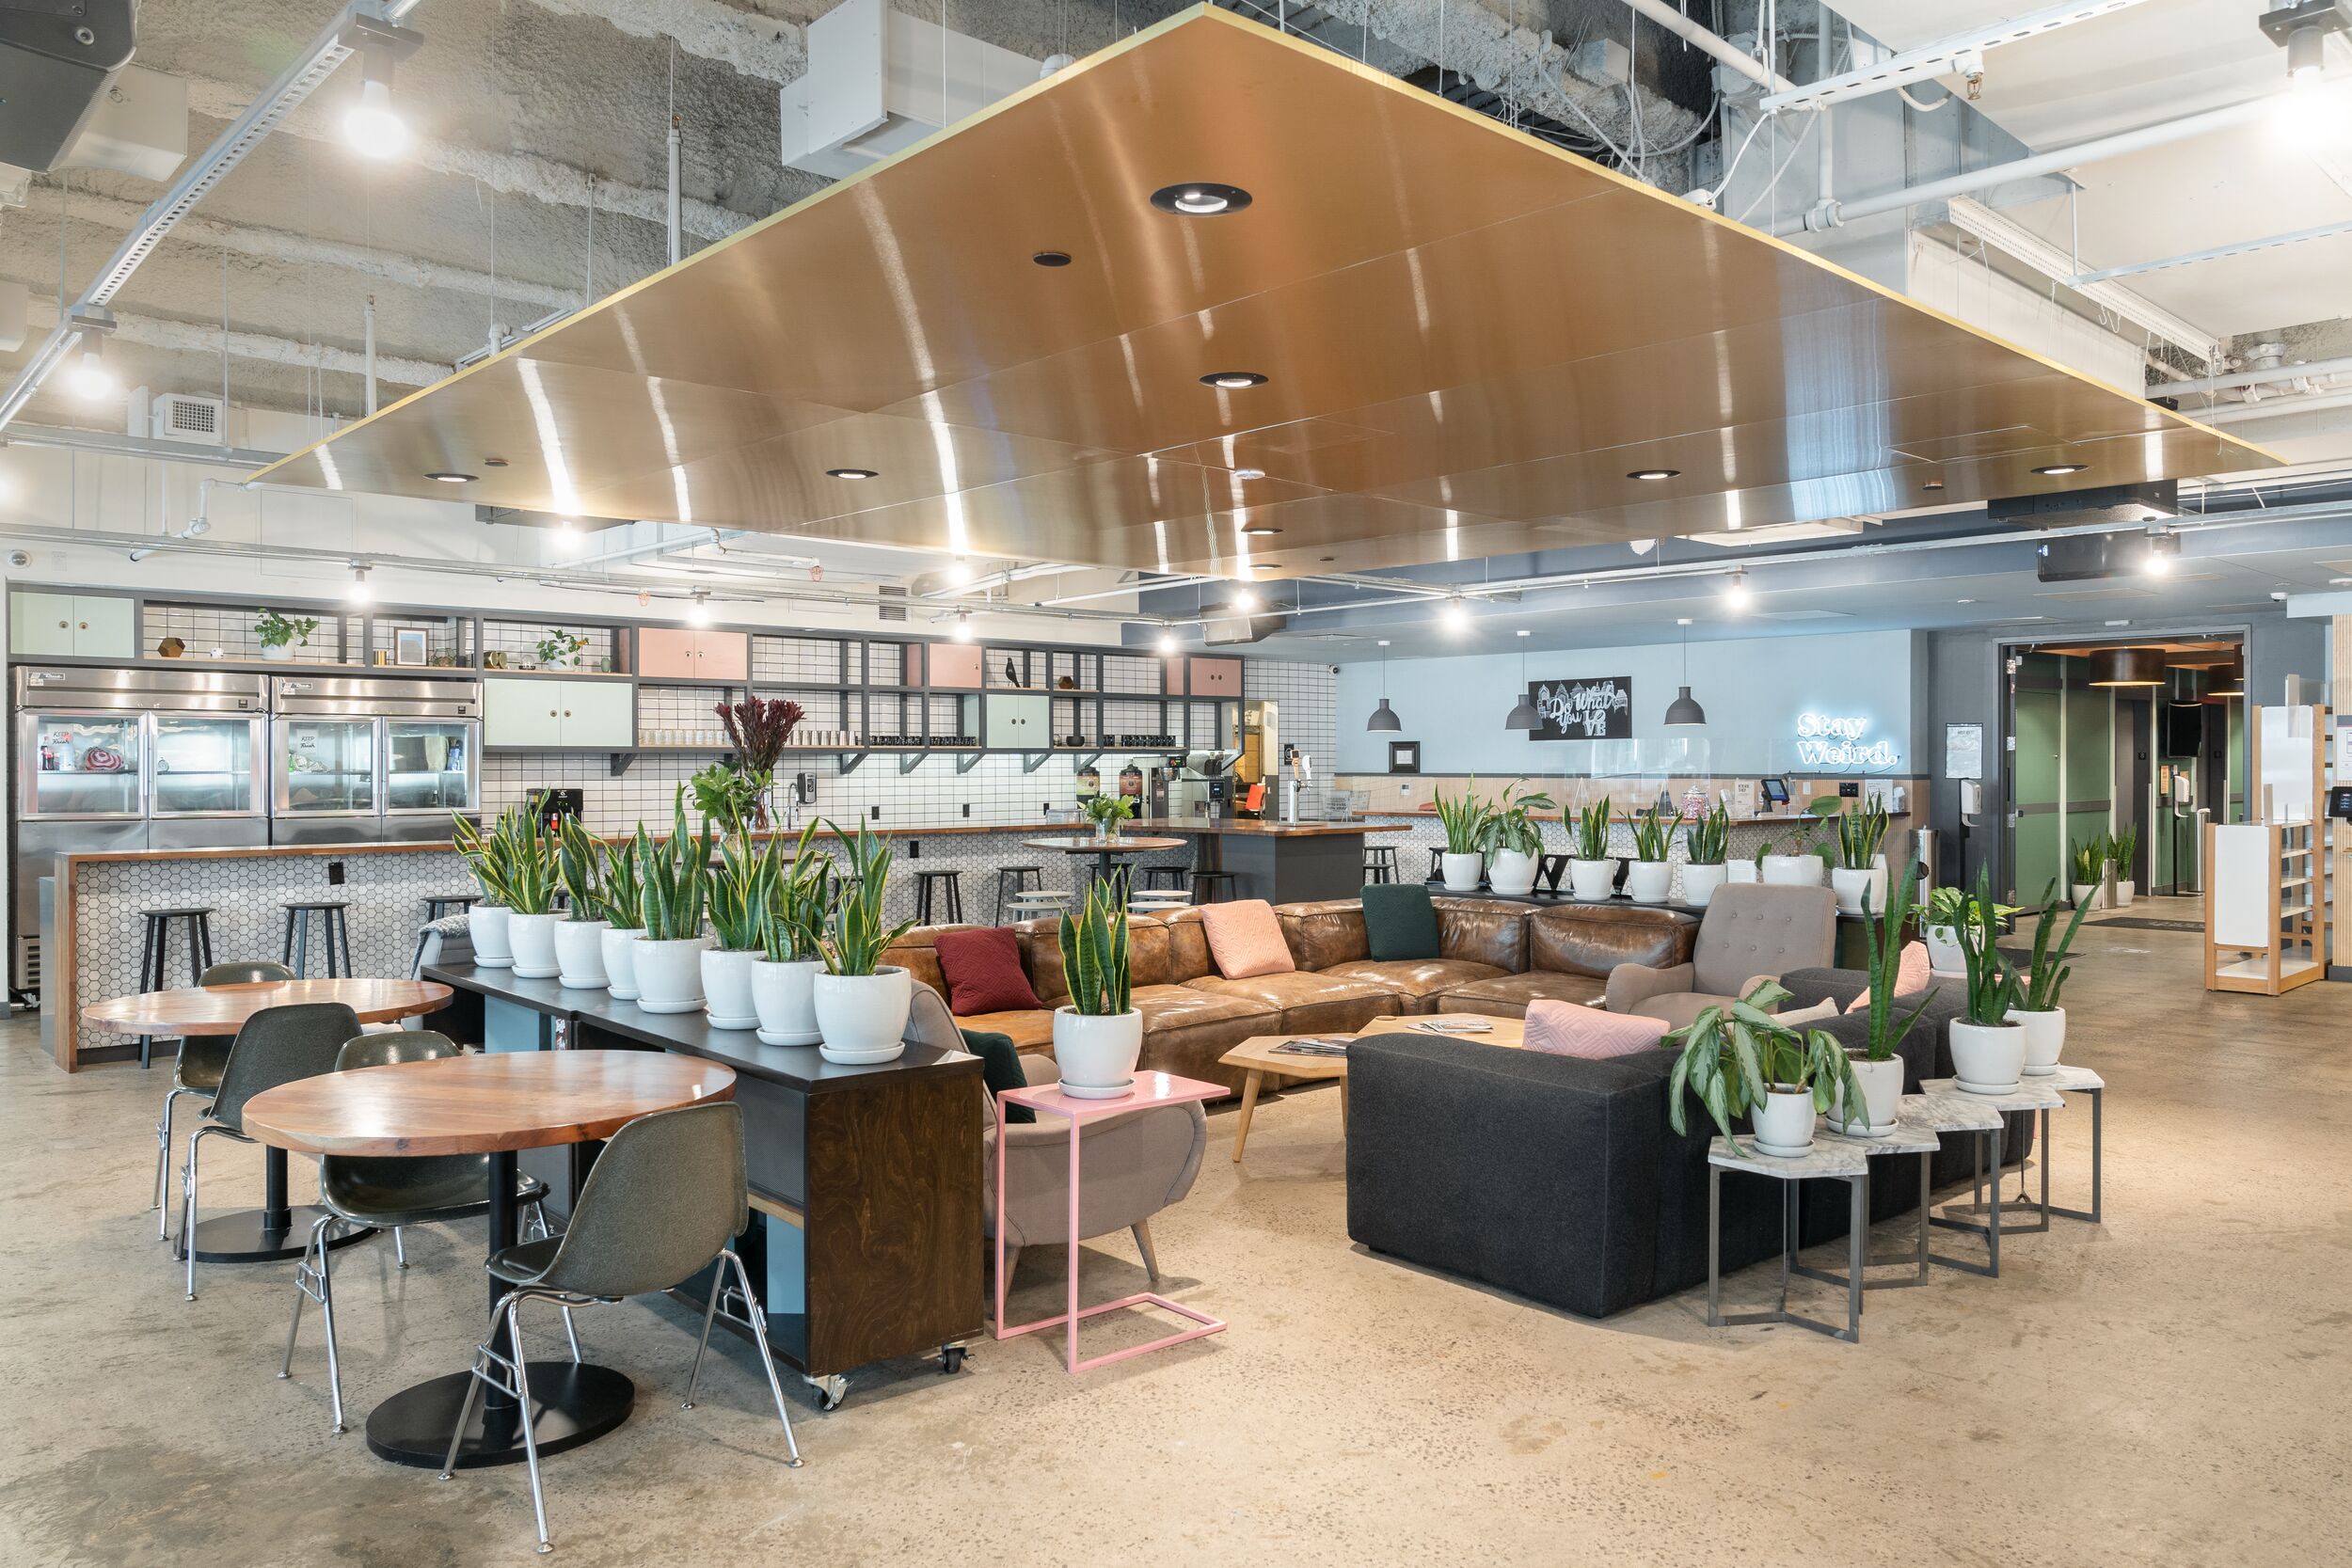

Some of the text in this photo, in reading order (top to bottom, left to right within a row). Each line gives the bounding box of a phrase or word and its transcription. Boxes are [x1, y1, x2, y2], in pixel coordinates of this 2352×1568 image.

[1549, 685, 1614, 719] Do What
[1556, 712, 1582, 734] you
[1797, 713, 1867, 740] Stay
[1797, 740, 1899, 766] Weird.
